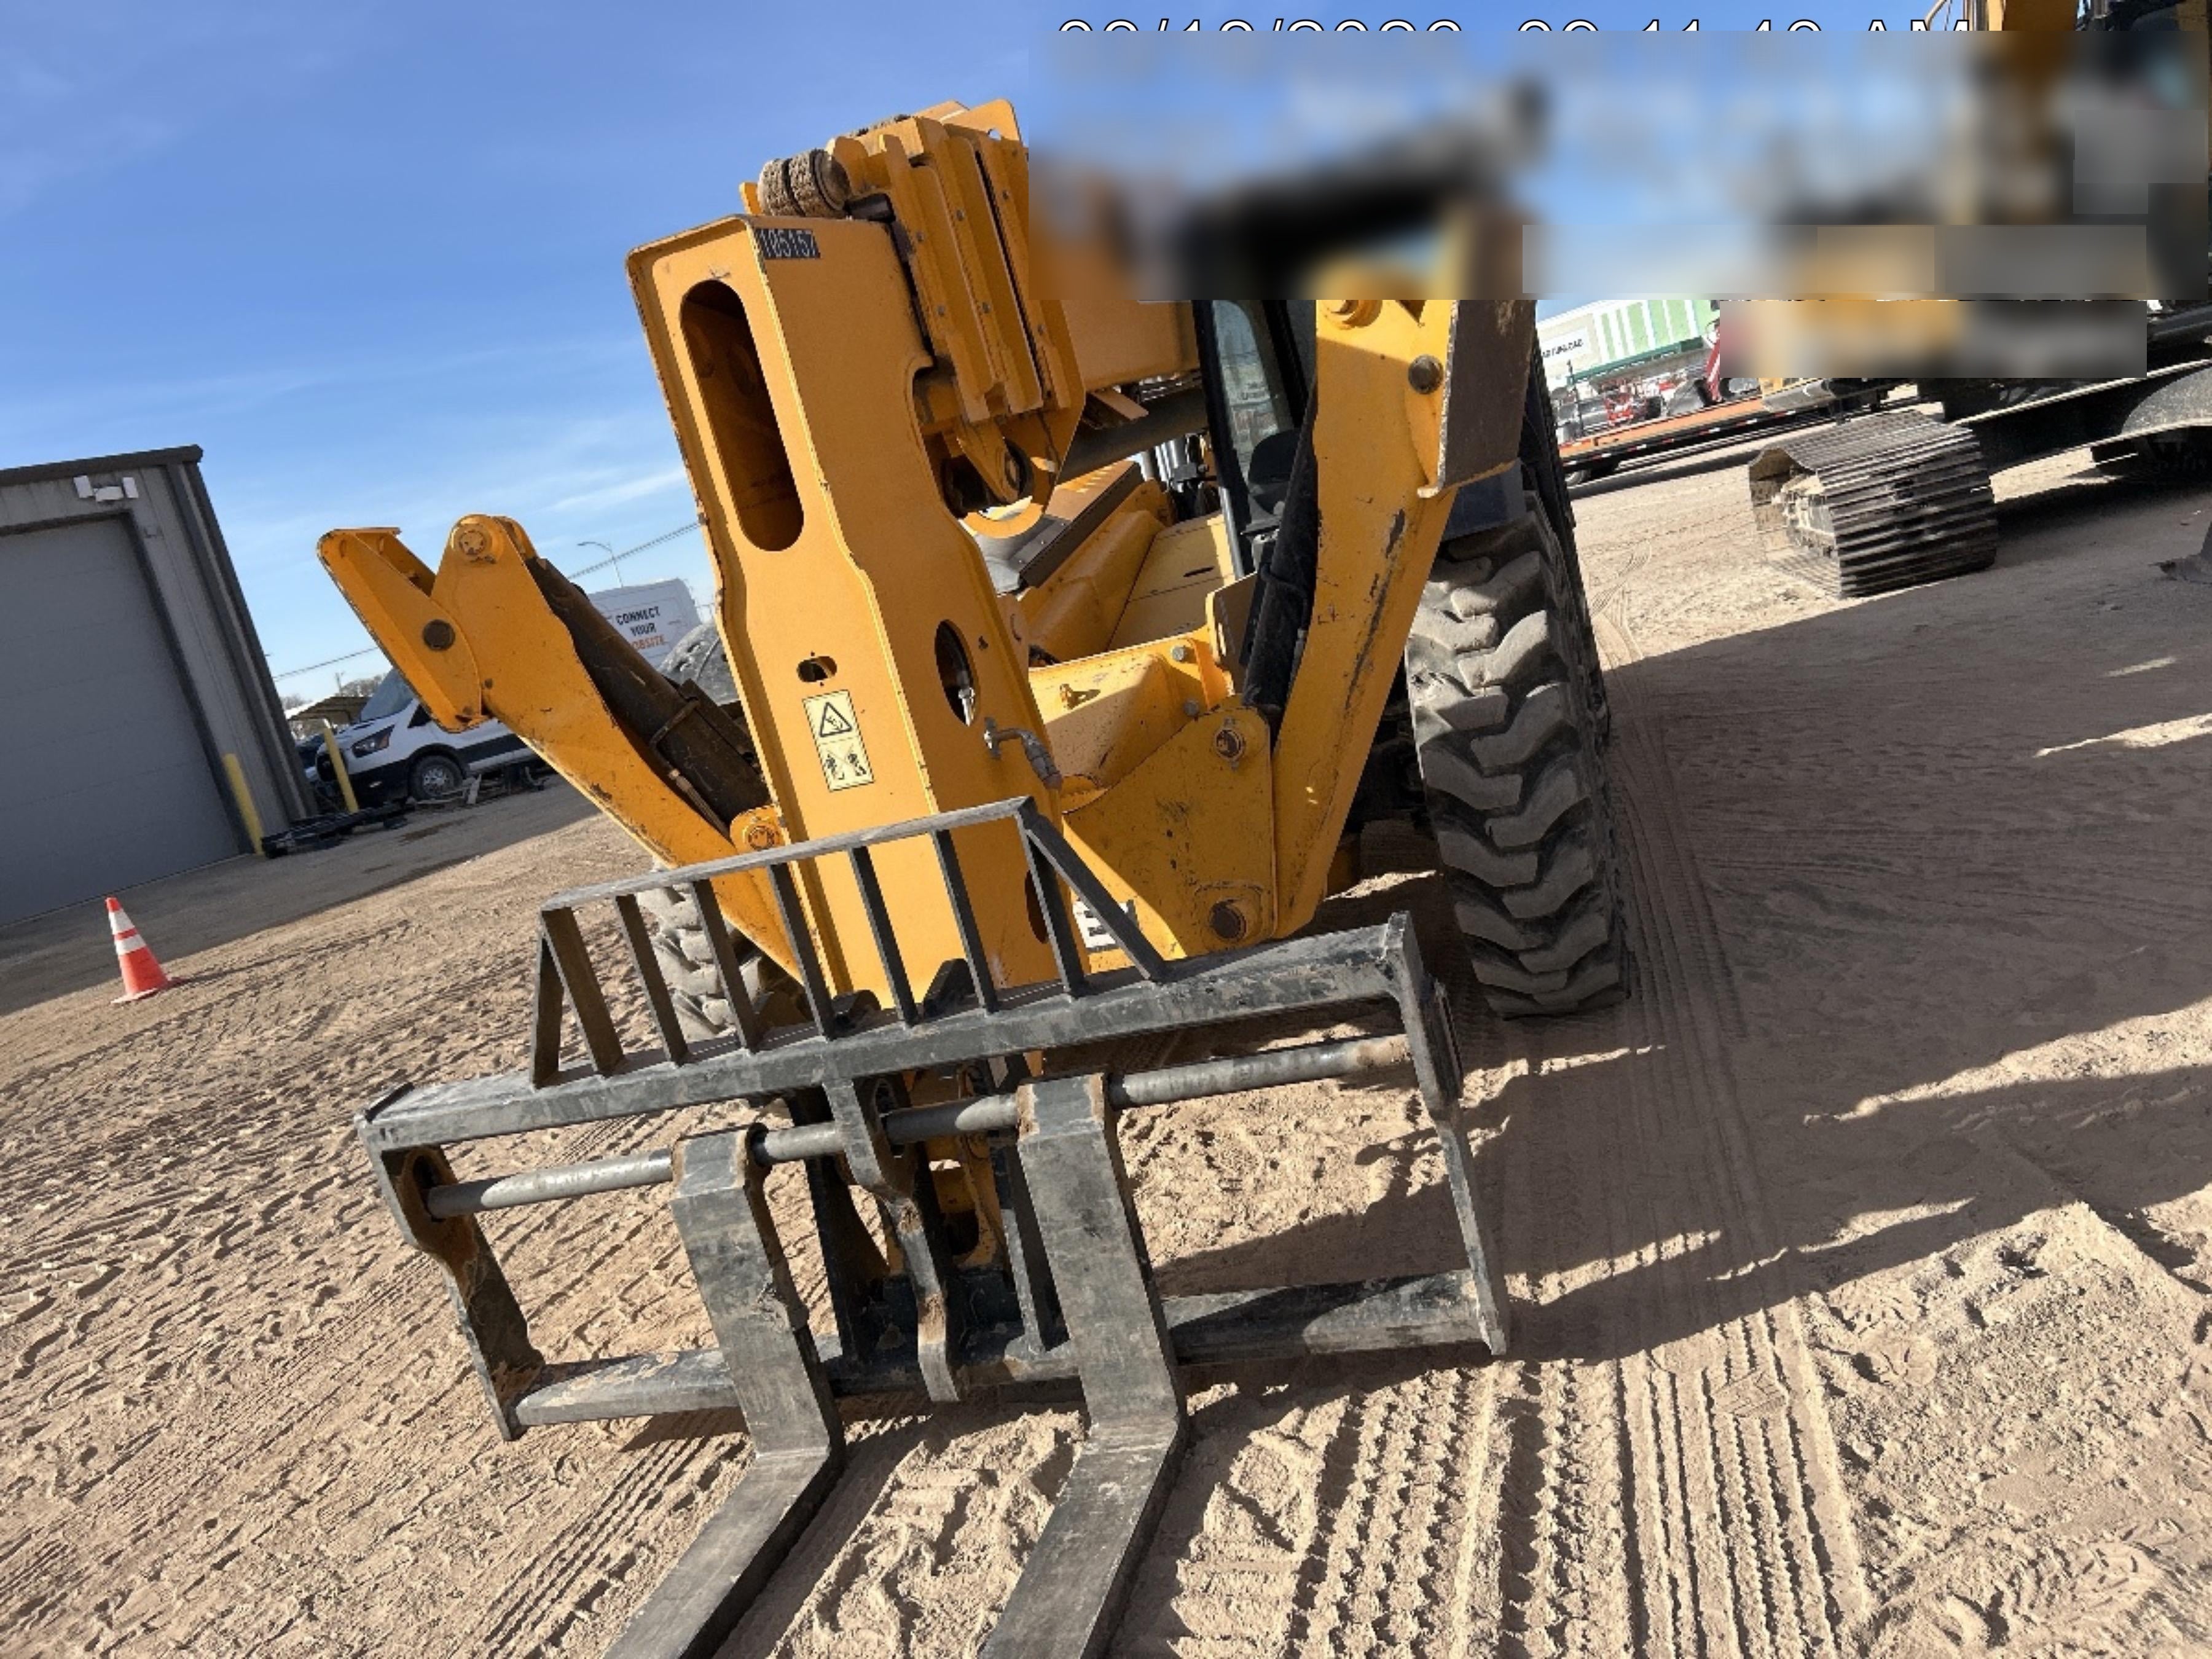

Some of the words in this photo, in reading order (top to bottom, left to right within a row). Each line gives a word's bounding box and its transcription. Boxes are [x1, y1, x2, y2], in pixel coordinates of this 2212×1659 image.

[616, 606, 660, 626] CONNECT
[630, 622, 656, 637] YOUR
[632, 635, 665, 649] OBSITE
